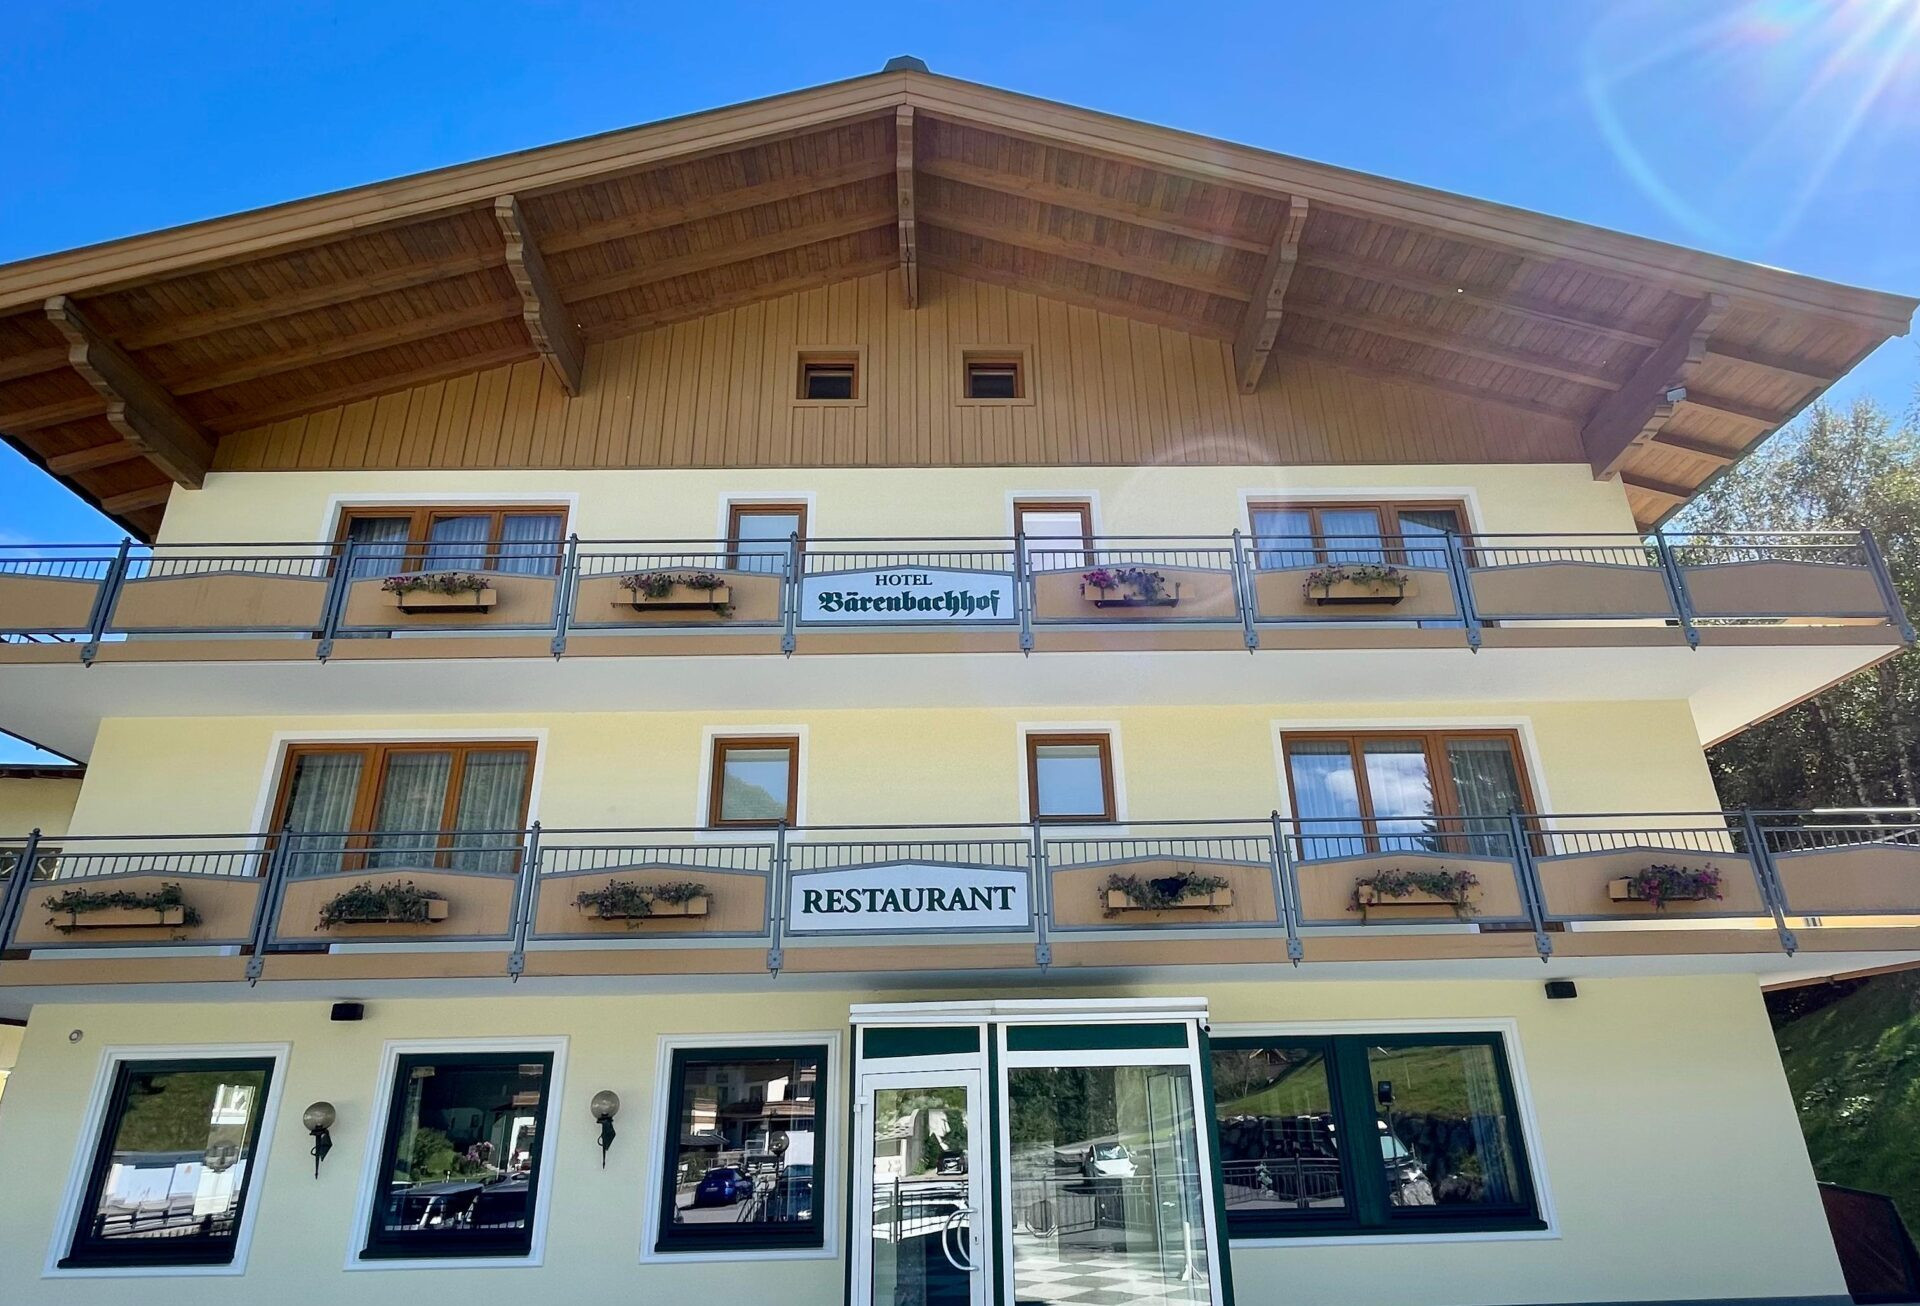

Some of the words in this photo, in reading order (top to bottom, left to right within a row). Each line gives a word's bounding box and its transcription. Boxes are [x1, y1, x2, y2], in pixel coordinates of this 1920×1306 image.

[875, 574, 933, 586] HOTEL
[818, 589, 1000, 617] Bärenbachhof
[802, 886, 1016, 914] RESTAURANT
